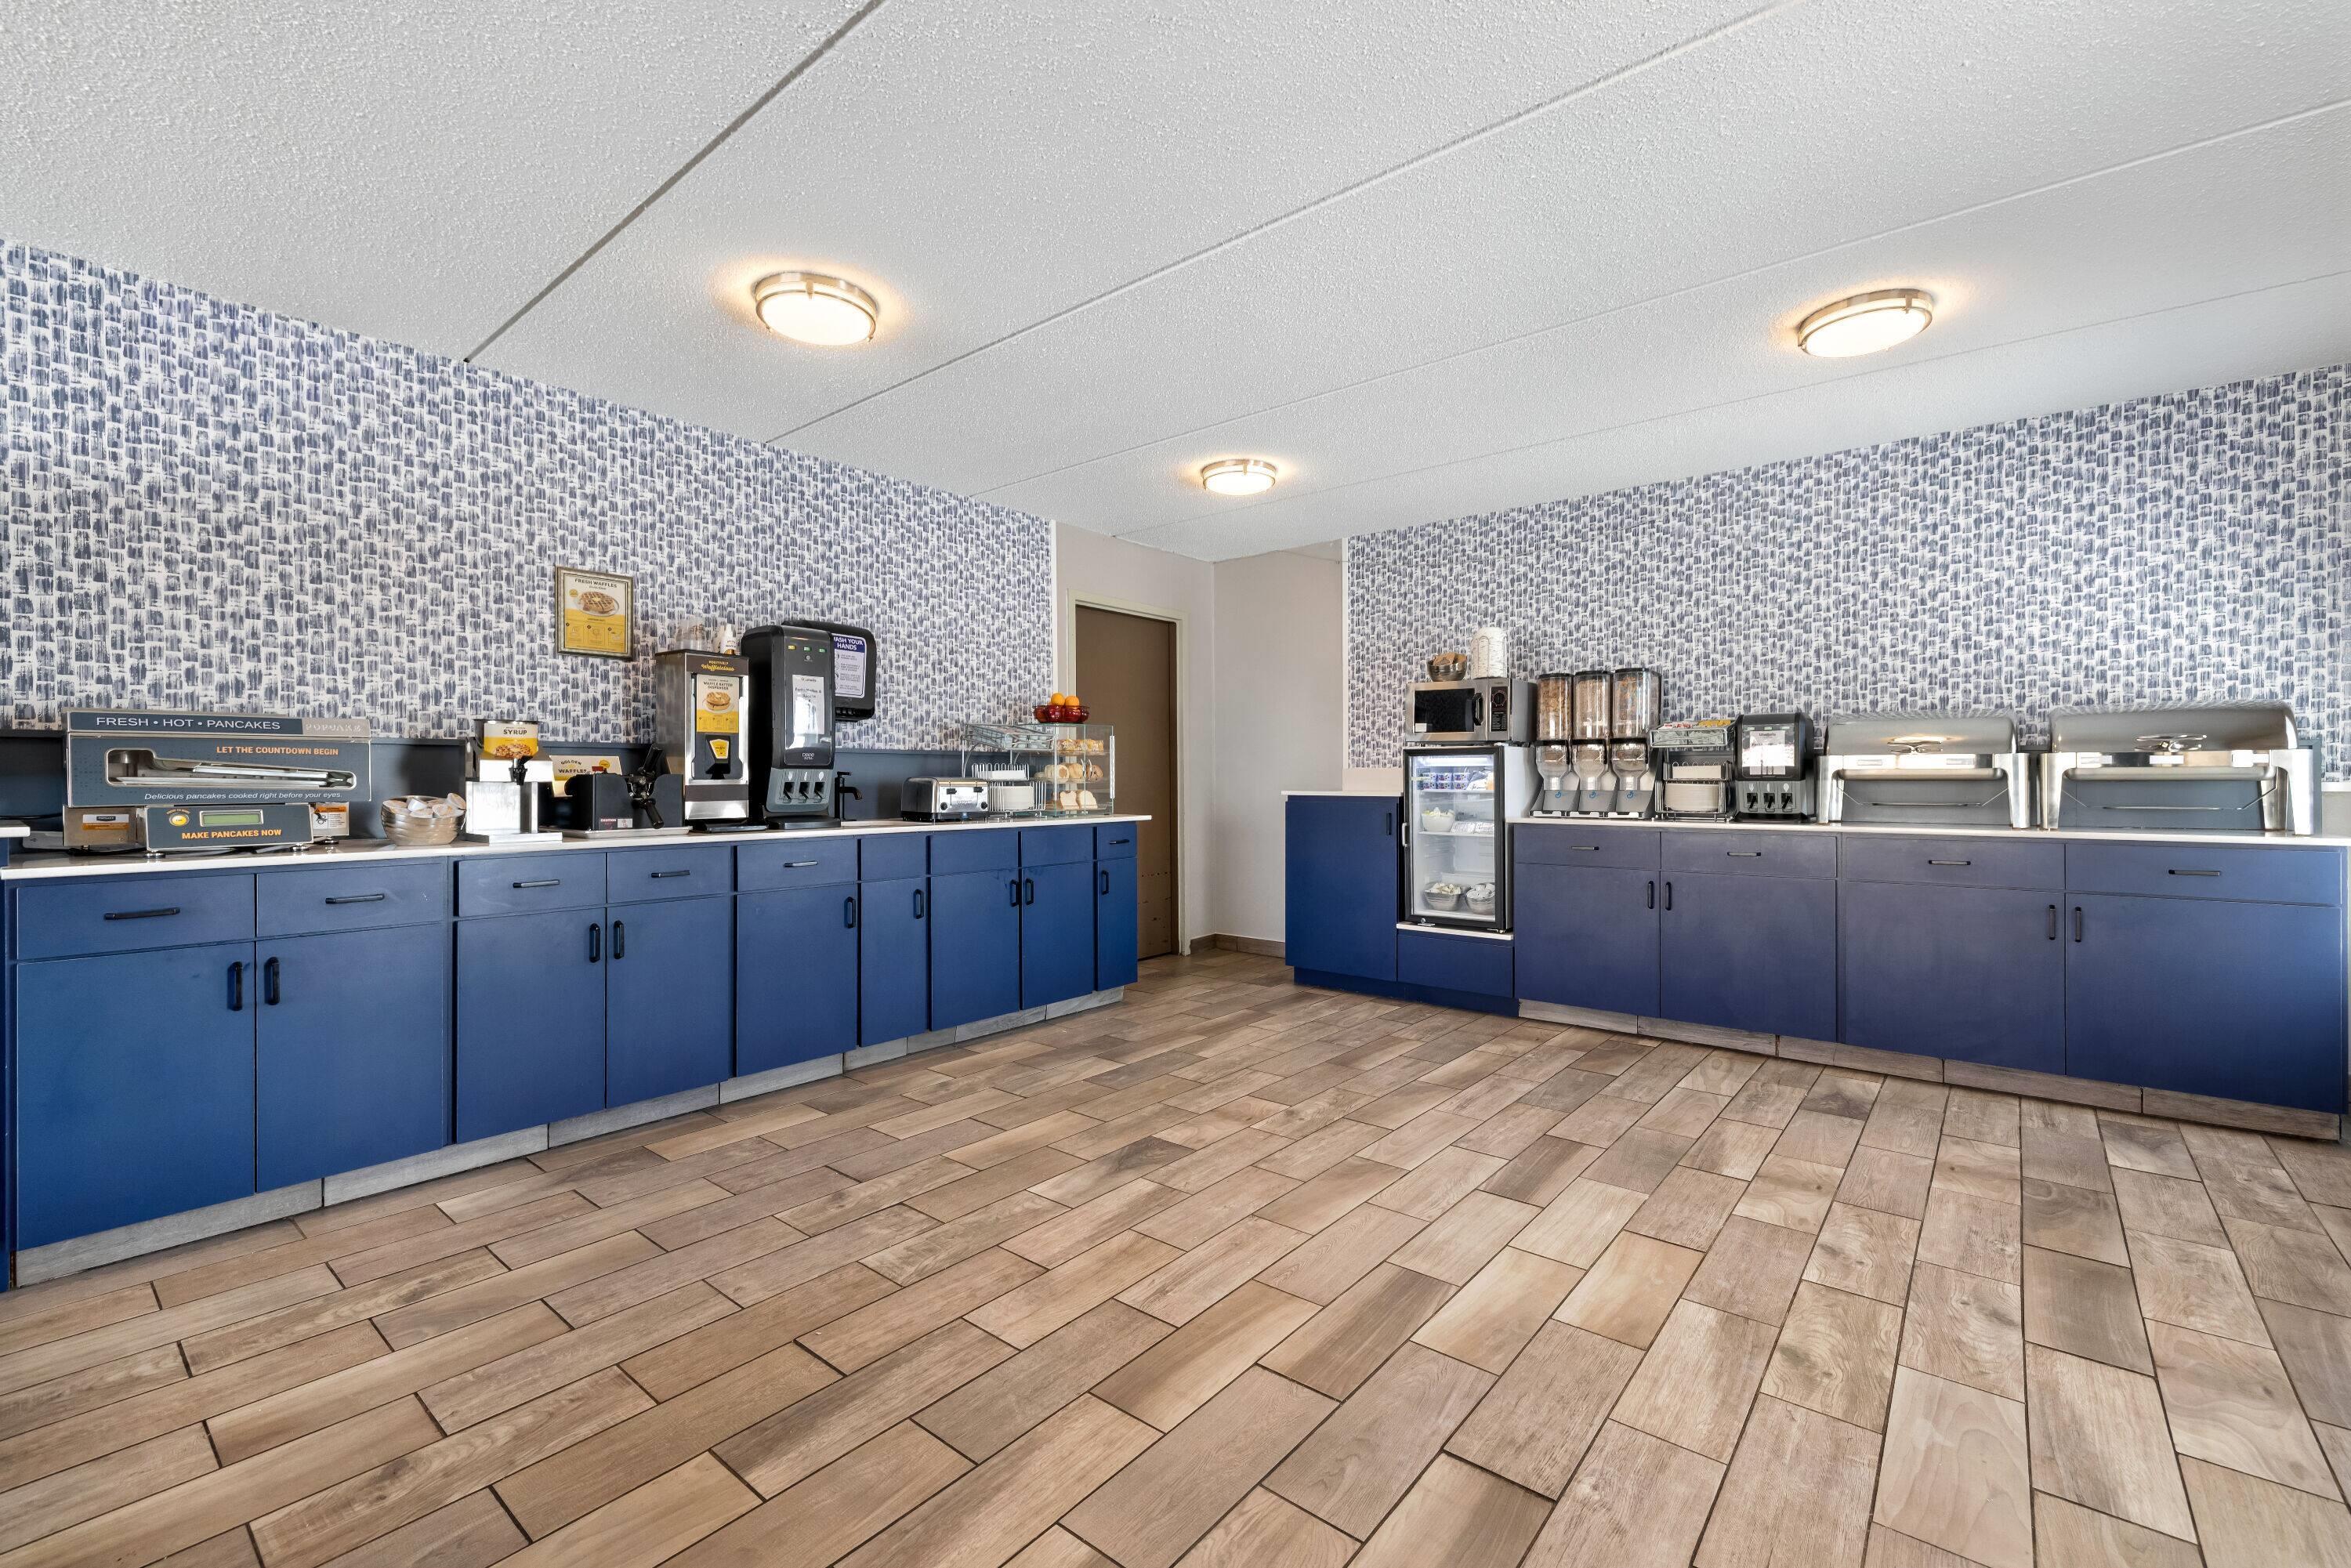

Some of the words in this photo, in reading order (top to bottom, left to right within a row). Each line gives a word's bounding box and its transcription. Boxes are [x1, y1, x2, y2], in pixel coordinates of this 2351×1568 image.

[96, 717, 149, 726] FRESH
[163, 719, 194, 727] HOT
[206, 719, 281, 730] PANCAKES
[259, 791, 277, 800] right
[211, 830, 259, 838] PANCAKES
